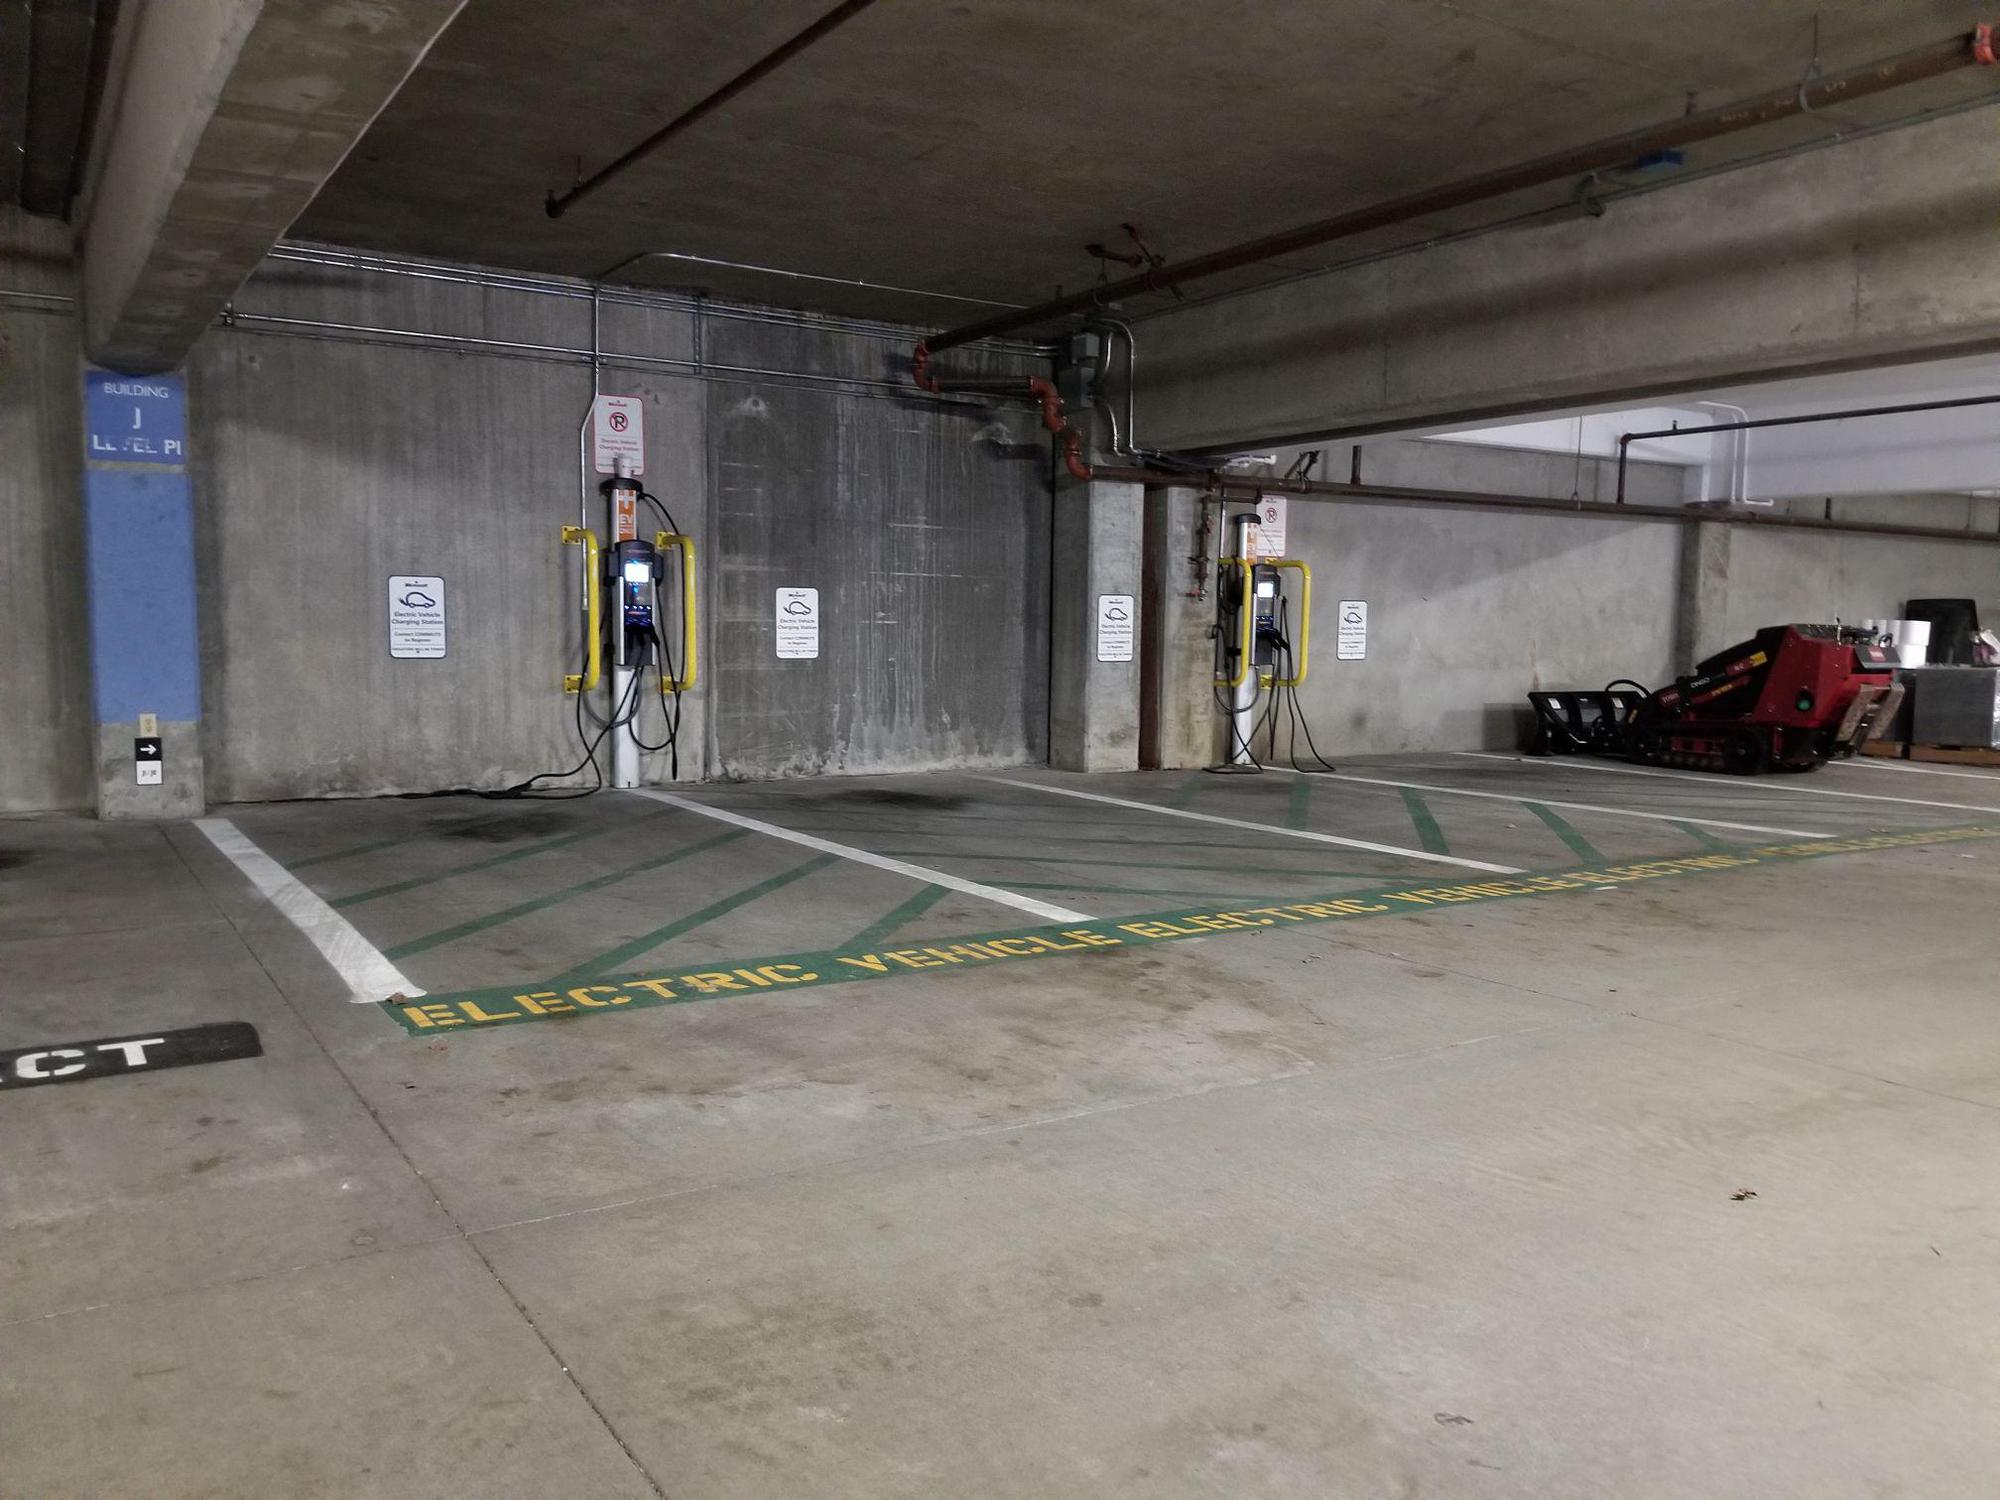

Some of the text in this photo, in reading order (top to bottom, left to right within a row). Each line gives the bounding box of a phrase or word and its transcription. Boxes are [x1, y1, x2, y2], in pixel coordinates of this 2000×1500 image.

[103, 382, 169, 399] BUILDING
[132, 407, 142, 430] J
[403, 963, 819, 1028] ELECTRIC
[834, 929, 1123, 972] VEHICLE
[1117, 899, 1389, 938] ELECTRIC
[1380, 876, 1586, 904] VEHICLE
[0, 1037, 166, 1082] CT
